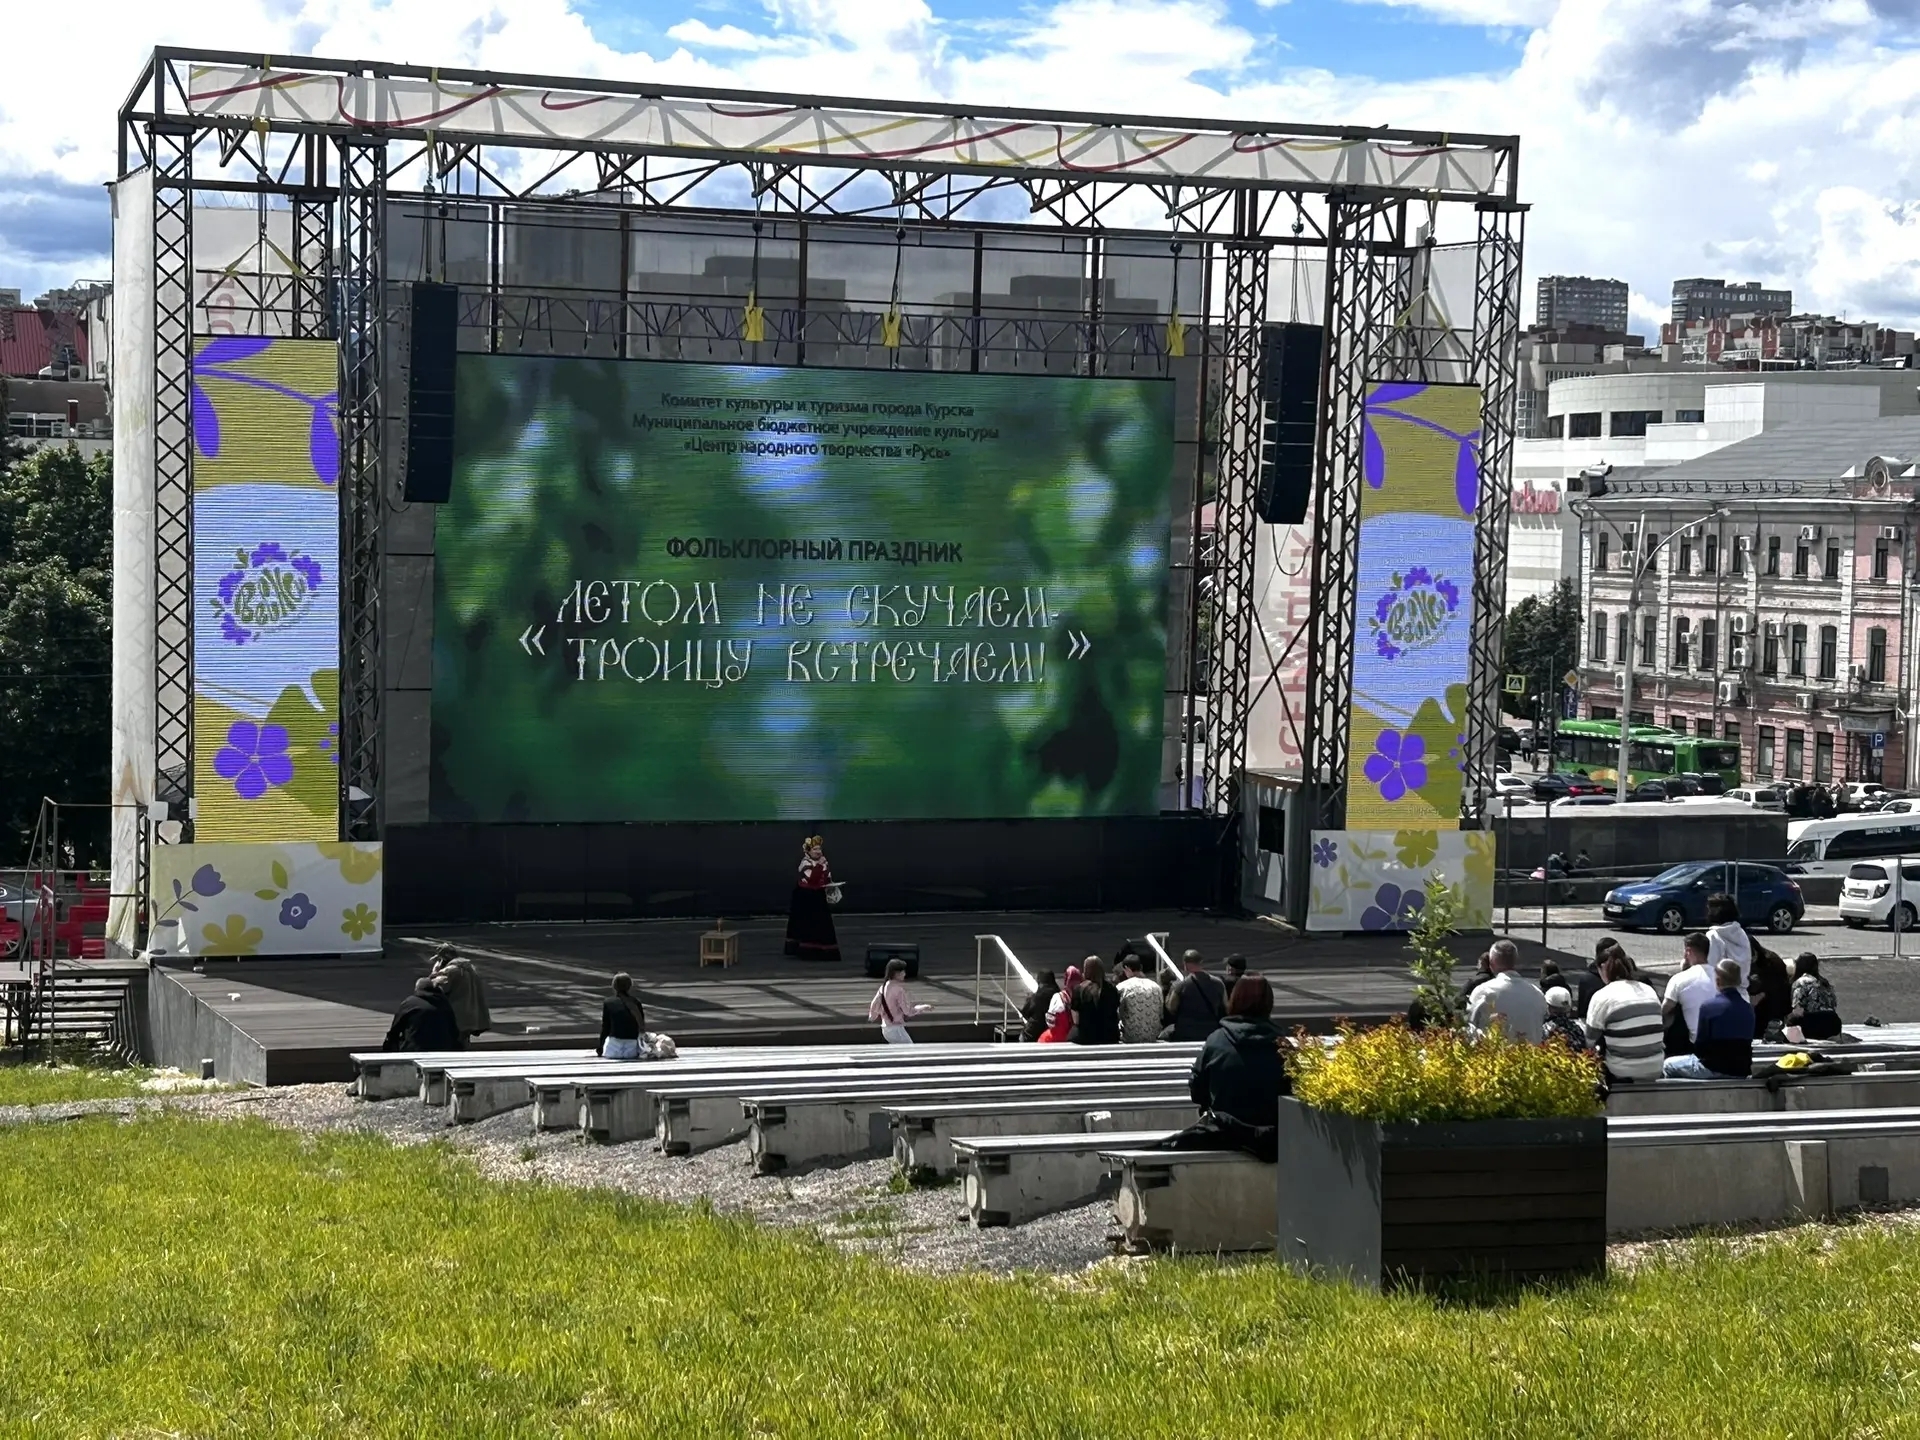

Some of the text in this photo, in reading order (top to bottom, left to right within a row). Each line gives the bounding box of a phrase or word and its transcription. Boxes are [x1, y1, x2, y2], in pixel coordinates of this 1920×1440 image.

[660, 392, 975, 420] Комитет культуры и туризма города Курска
[632, 412, 999, 442] Муниципальное бюджетное учреждение культуры
[683, 436, 951, 461] «Центр народного творчества «Русь»
[666, 536, 964, 566] ФОЛЬКЛОРНЫЙ ПРАЗДНИК
[556, 578, 722, 626] ЛЕТОМ
[757, 583, 814, 625] НЕ
[788, 640, 1046, 683] ВСТРЕЧАЕМ!
